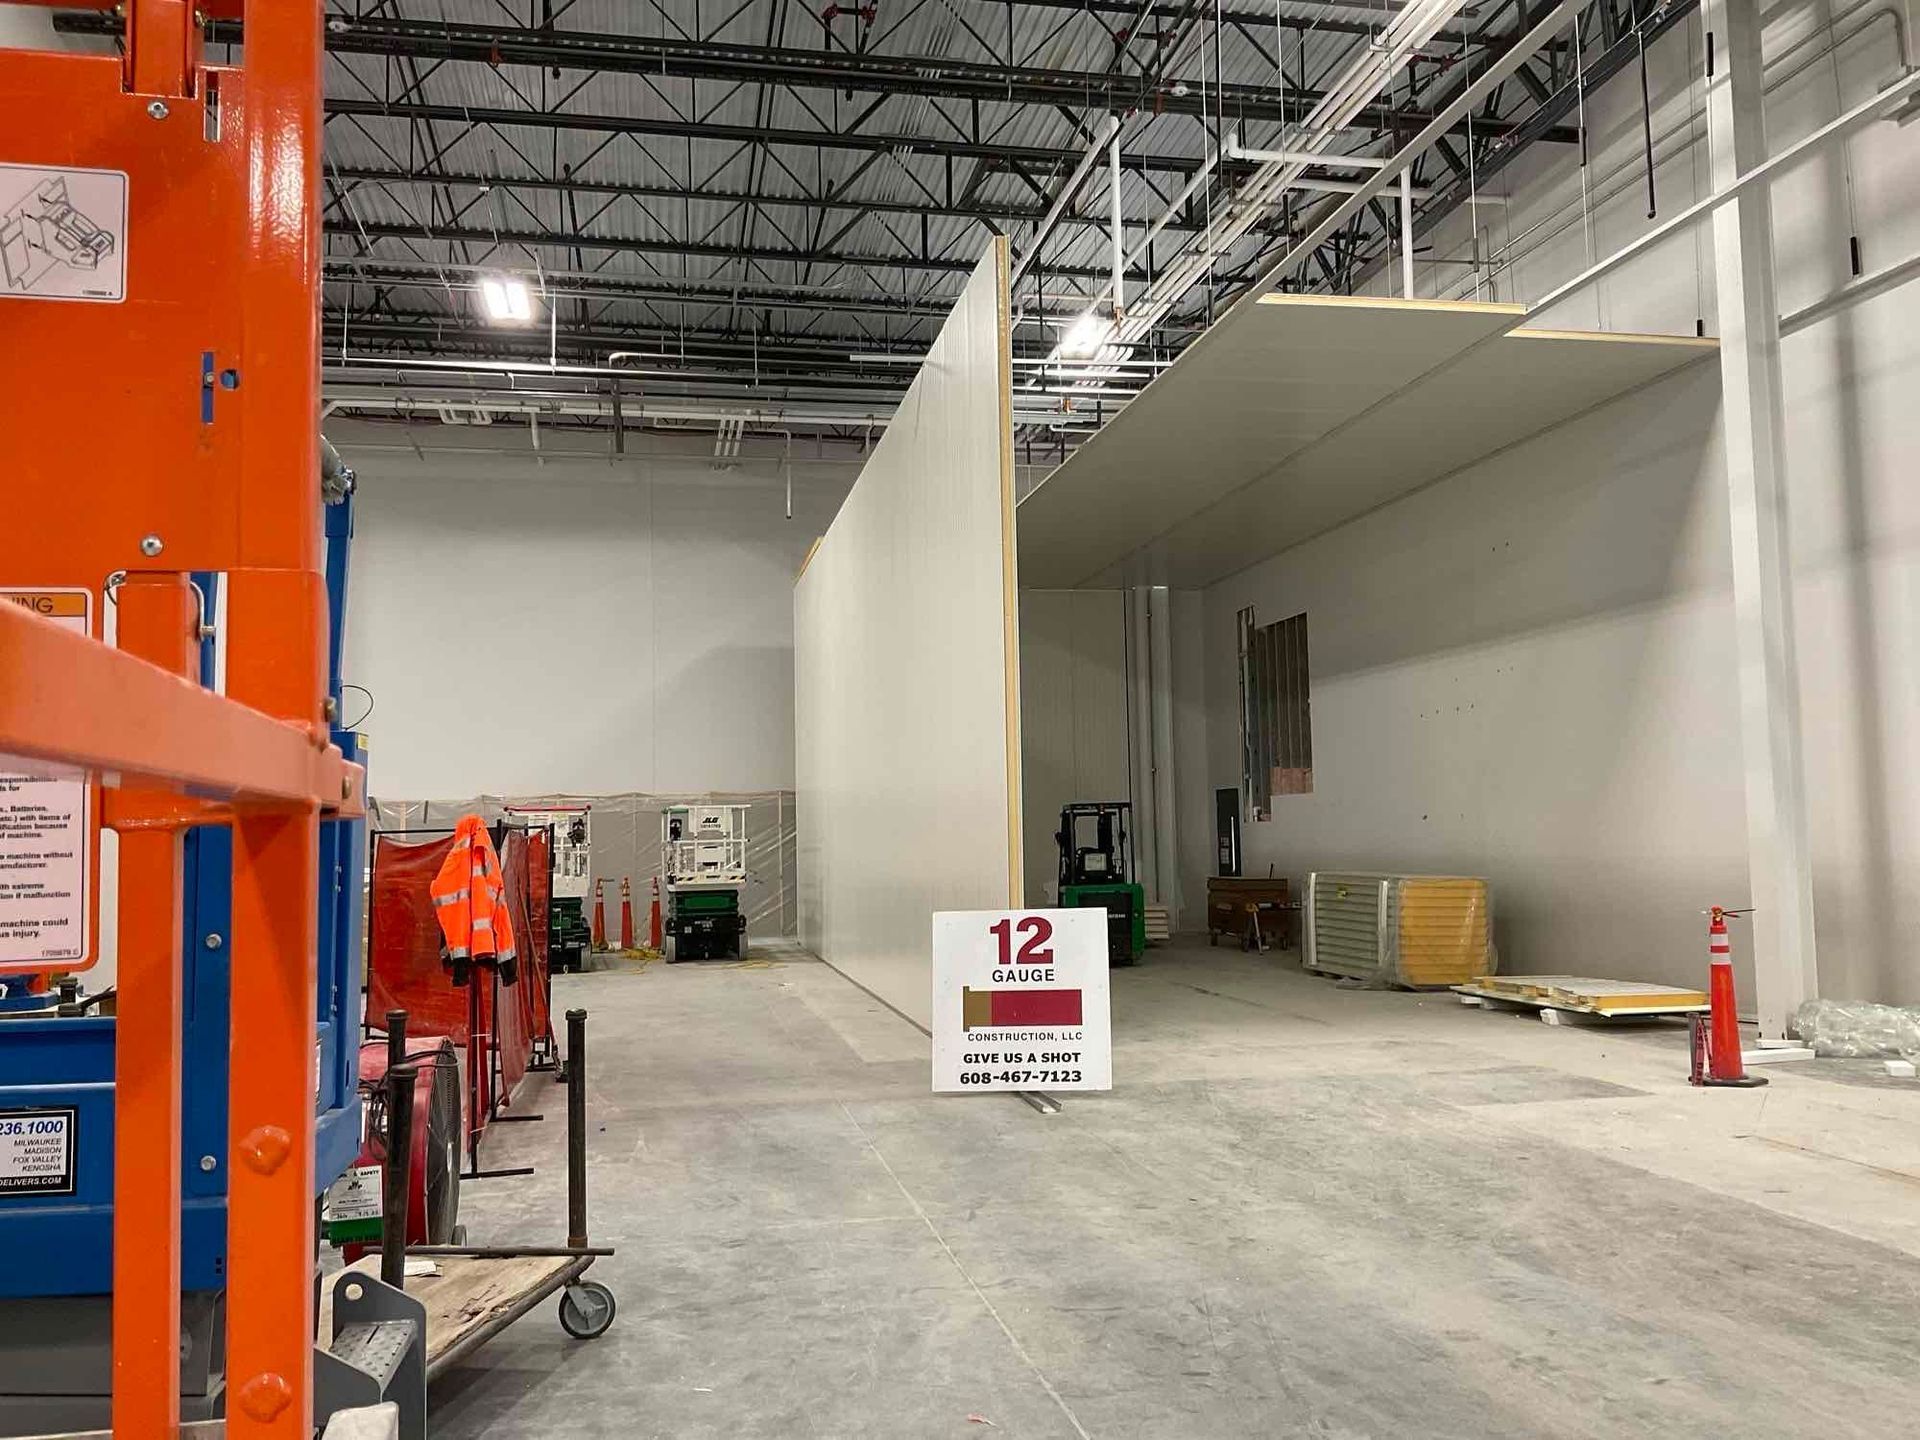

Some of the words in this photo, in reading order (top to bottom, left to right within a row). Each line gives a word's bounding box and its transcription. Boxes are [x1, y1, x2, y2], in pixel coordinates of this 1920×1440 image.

[6, 851, 41, 859] machine
[43, 850, 73, 858] without
[23, 891, 71, 899] malfunction
[42, 918, 68, 926] could
[989, 916, 1054, 965] 12
[992, 969, 1055, 983] GAUGE
[967, 1031, 1058, 1042] CONSTRUCTION,
[1061, 1031, 1083, 1041] LLC
[963, 1053, 999, 1064] GIVE
[1004, 1053, 1023, 1063] US
[1027, 1053, 1037, 1063] A
[1041, 1052, 1081, 1063] SHOT
[960, 1070, 1082, 1084] 608-467-7123
[0, 1120, 63, 1136] 236.1000
[14, 1138, 62, 1146] MILWAUKEE
[32, 1155, 62, 1163] VALLEY
[22, 1164, 61, 1172] KENOSHA
